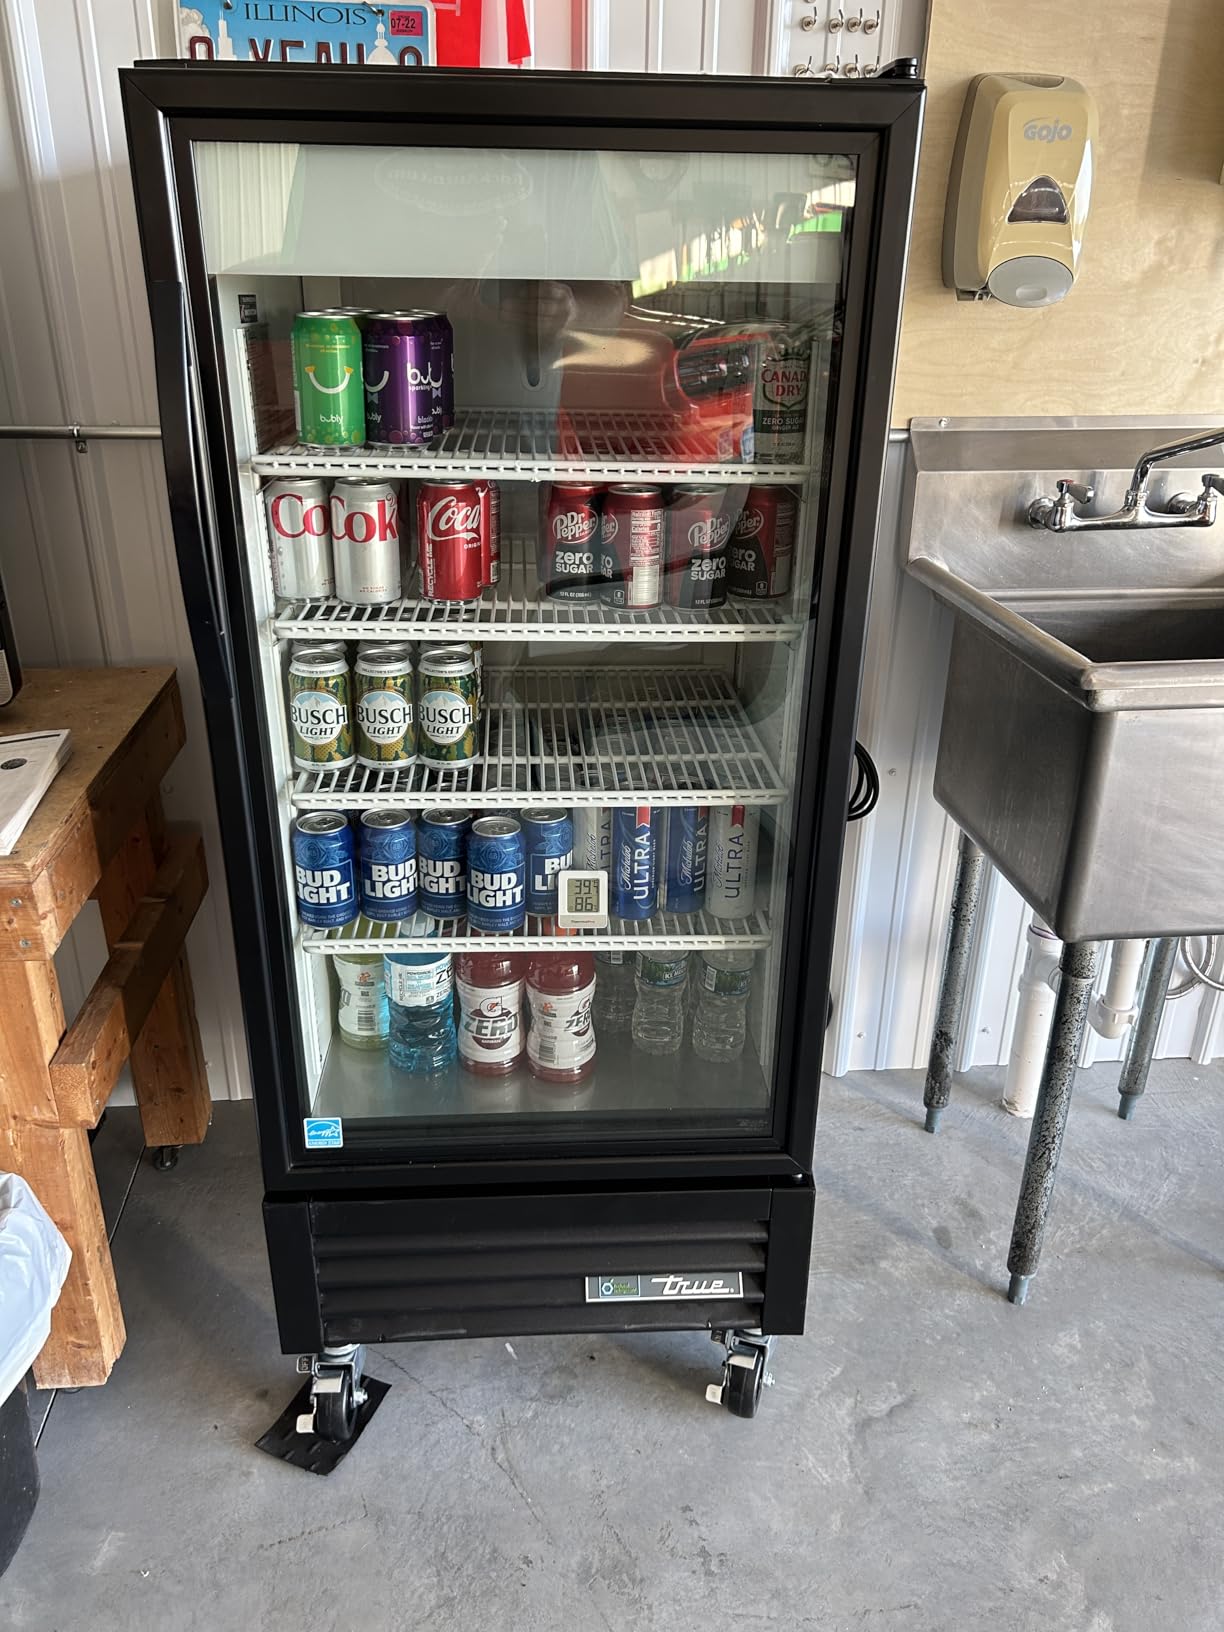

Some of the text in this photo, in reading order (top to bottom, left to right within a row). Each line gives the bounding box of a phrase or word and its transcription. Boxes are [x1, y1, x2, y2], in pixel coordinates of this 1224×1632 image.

[244, 3, 367, 25] ILLINOIS
[391, 18, 416, 29] 07-22
[761, 369, 807, 384] CANAD
[775, 384, 803, 397] DRY
[320, 413, 344, 425] bubly
[762, 417, 784, 425] ZERO
[271, 493, 330, 539] Co
[567, 511, 586, 527] Dr
[707, 517, 723, 530] Dr
[556, 514, 596, 540] Pepper
[693, 521, 729, 547] Pepper
[555, 550, 594, 565] zero
[690, 557, 727, 571] zero
[426, 543, 434, 597] RECYCLE ME
[555, 563, 593, 573] SUGAR
[690, 568, 726, 580] SUGAR
[291, 704, 346, 725] BUSCH
[357, 704, 412, 724] BUSCH
[419, 704, 472, 724] BUSCH
[300, 726, 336, 736] LIGHT
[366, 725, 402, 735] LIGHT
[426, 725, 462, 735] LIGHT
[419, 855, 461, 878] BUD
[545, 850, 573, 875] BU
[633, 831, 651, 900] ULTRA
[693, 823, 708, 892] ULTRA
[724, 832, 744, 899] ULTRA
[295, 865, 341, 888] BUD
[371, 858, 416, 882] BUD
[470, 869, 517, 891] BUD
[467, 884, 524, 907] LIGHT
[575, 896, 594, 911] 86
[463, 1012, 519, 1037] ZERO
